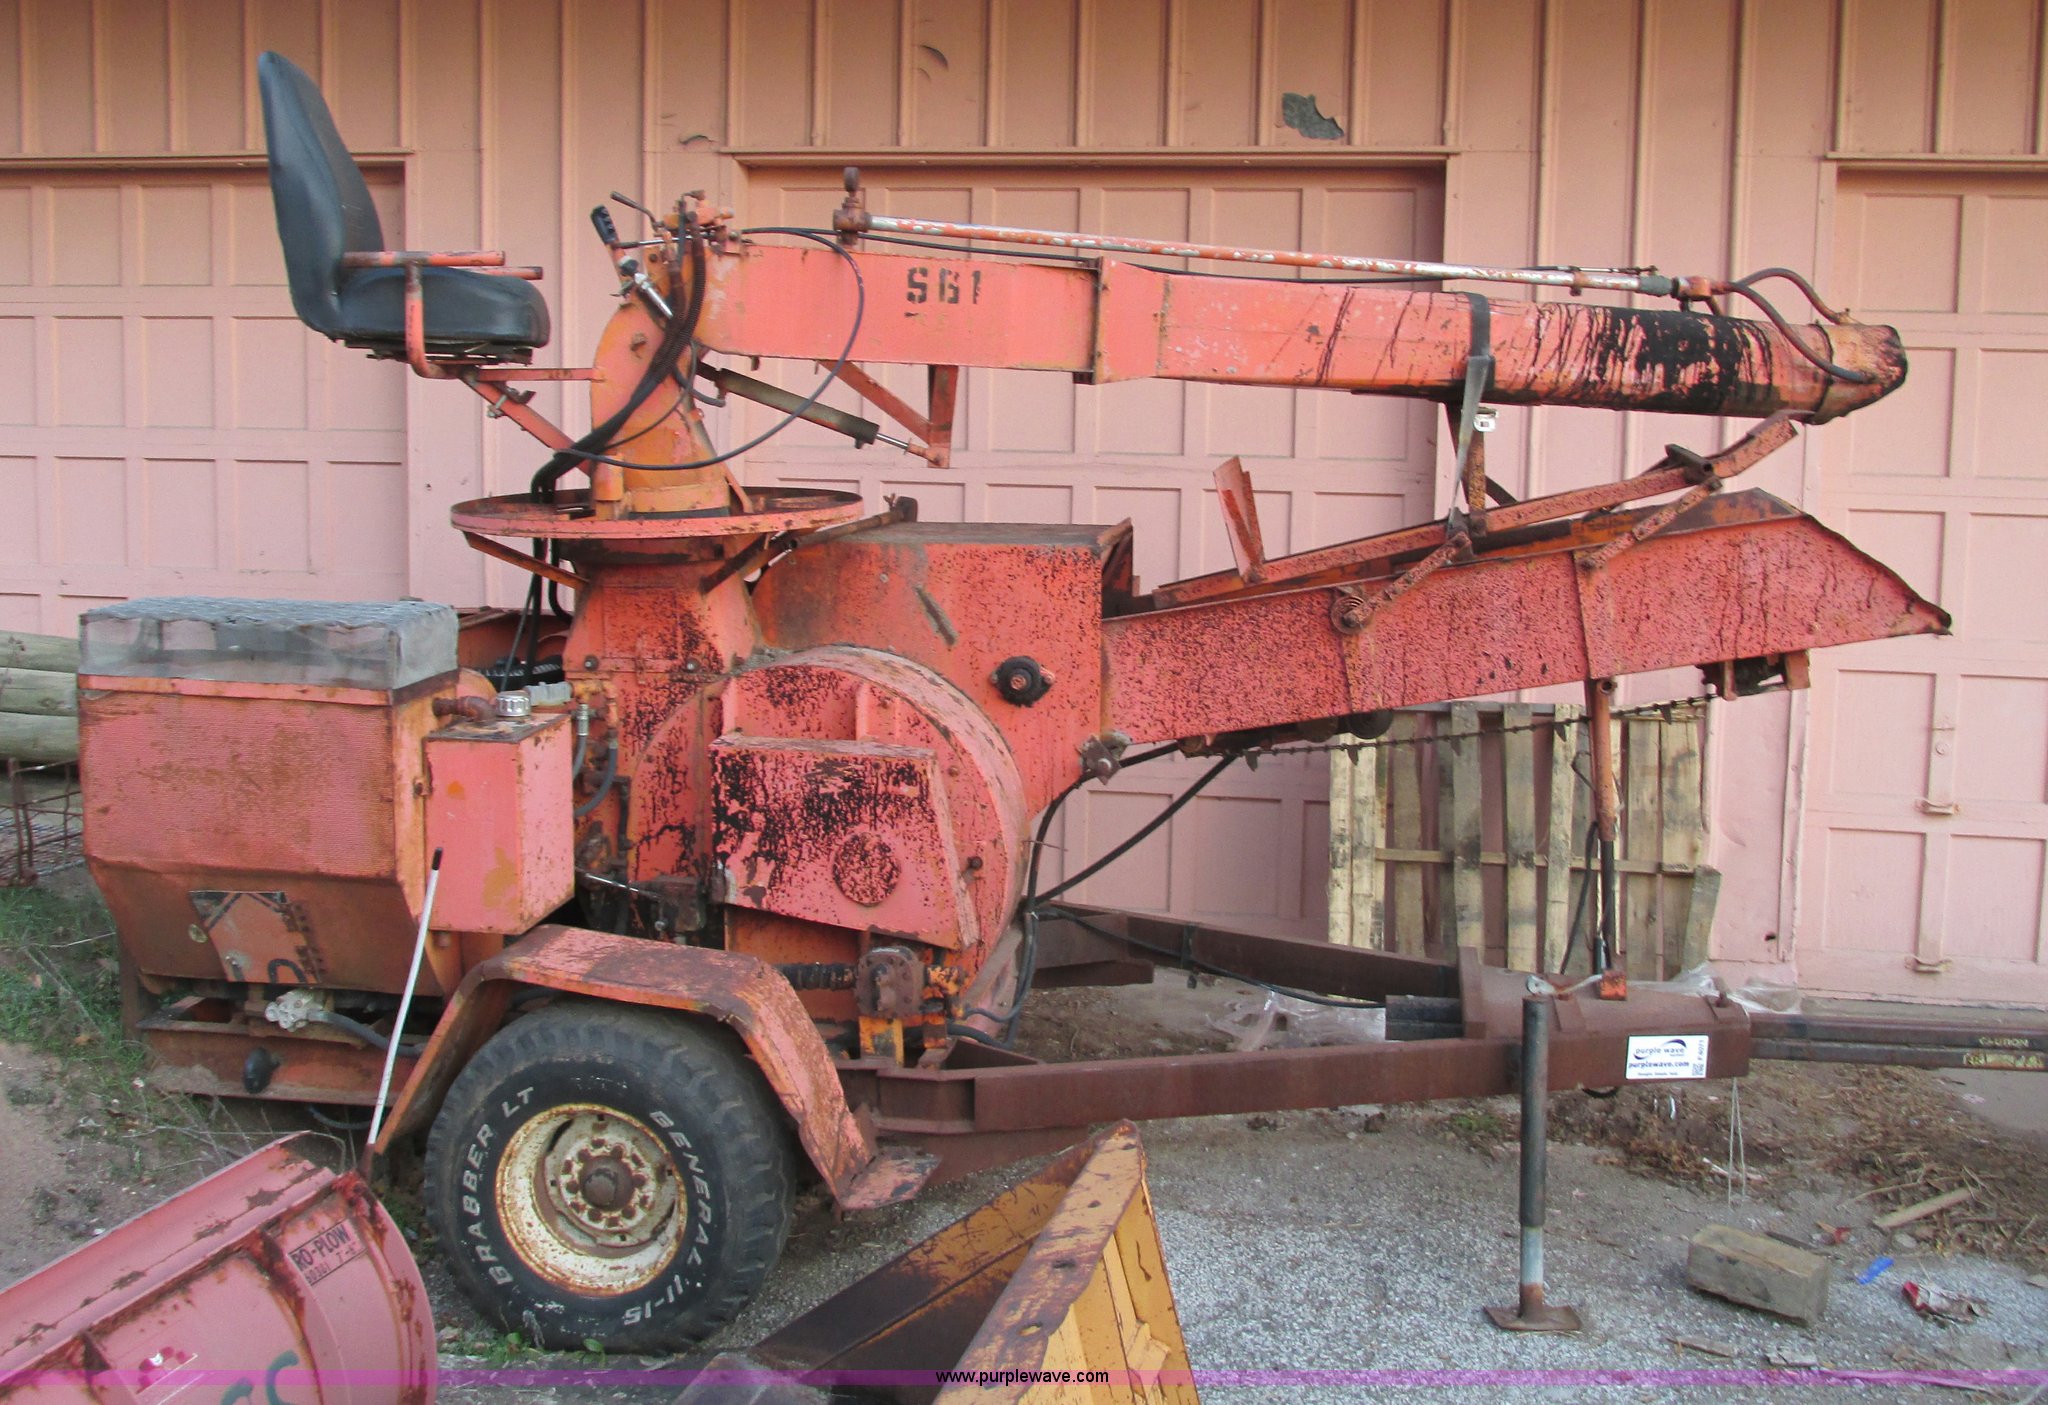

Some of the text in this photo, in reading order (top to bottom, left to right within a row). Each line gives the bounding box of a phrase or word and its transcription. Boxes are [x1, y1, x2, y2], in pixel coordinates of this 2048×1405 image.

[1629, 1060, 1690, 1069] purplewave.com
[1635, 1047, 1661, 1055] purple
[462, 1086, 535, 1286] GRABBER LT
[650, 1110, 713, 1266] GENERAL
